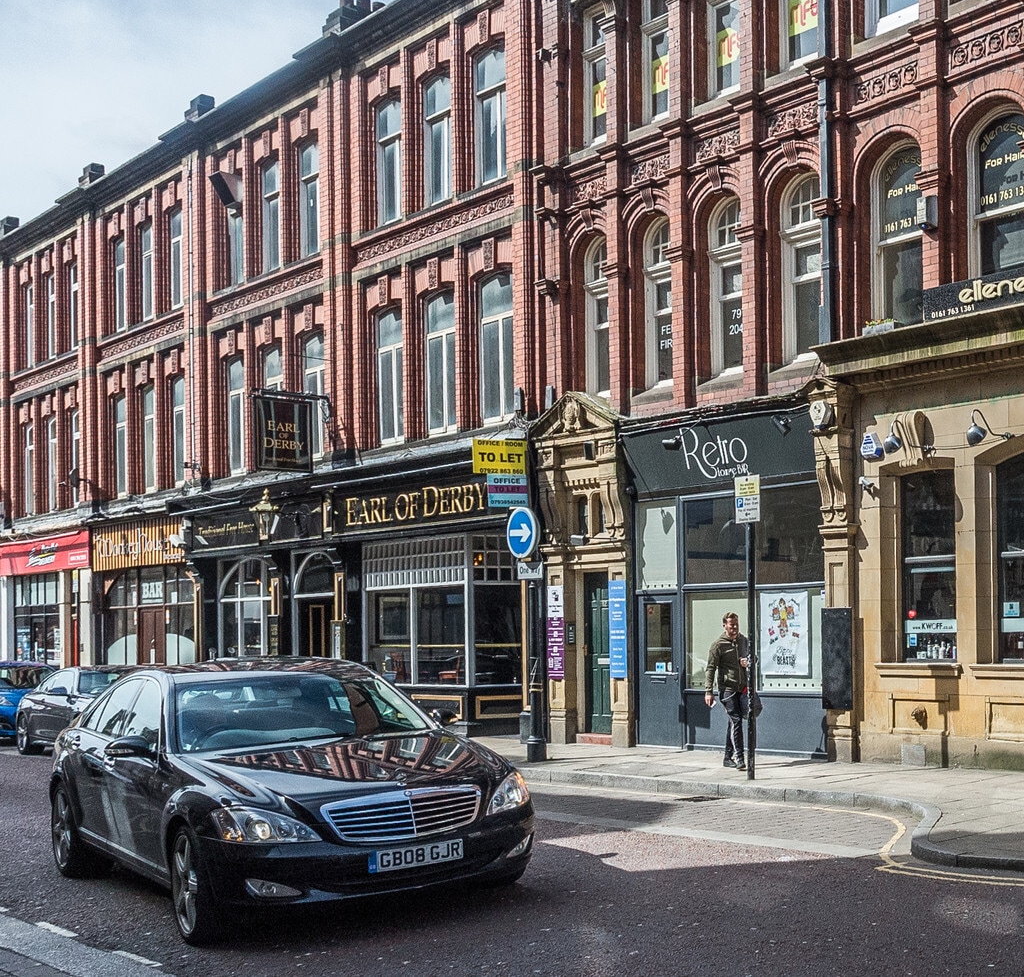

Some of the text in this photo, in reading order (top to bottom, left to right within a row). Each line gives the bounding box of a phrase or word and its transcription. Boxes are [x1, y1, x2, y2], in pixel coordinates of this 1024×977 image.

[884, 154, 922, 182] elleness
[980, 193, 997, 206] 0161
[1000, 188, 1013, 201] 763
[900, 218, 911, 230] 763
[931, 304, 975, 319] 0161 763 1361
[267, 420, 300, 434] EARL
[263, 438, 304, 450] DERBY
[478, 452, 523, 463] TO LET
[679, 427, 748, 479] Retro
[345, 482, 488, 527] EARL OF DERBY
[142, 582, 163, 598] BAR
[380, 841, 460, 869] GB08 GJR
